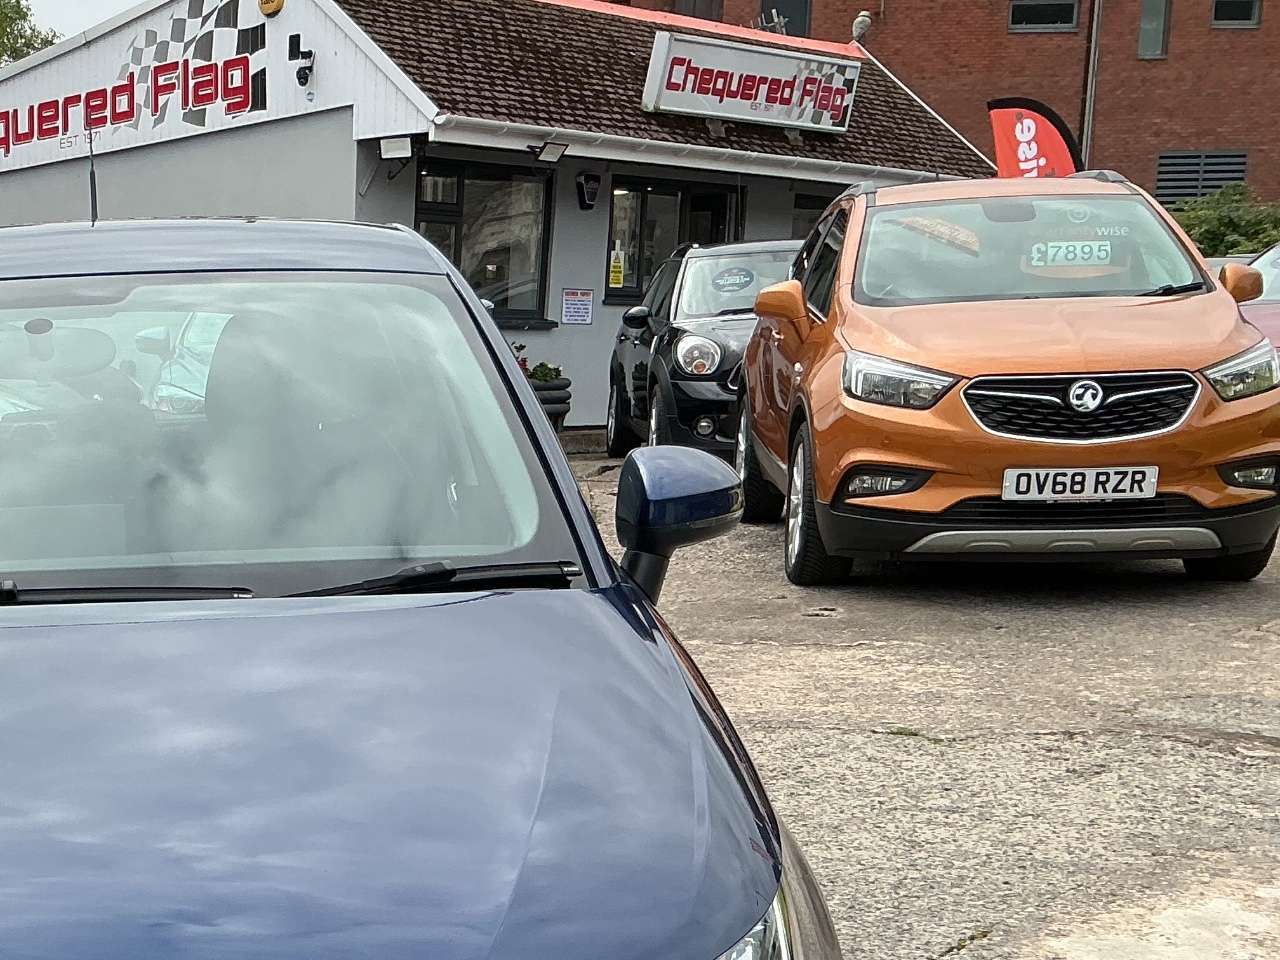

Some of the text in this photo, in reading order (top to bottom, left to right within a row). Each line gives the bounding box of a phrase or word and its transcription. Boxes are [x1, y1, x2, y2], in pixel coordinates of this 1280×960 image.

[152, 55, 250, 117] Flag
[666, 56, 848, 121] Chequered Flag
[60, 130, 102, 149] EST 1971
[1030, 243, 1110, 266] £7895
[1015, 470, 1147, 495] OV68 RZR
